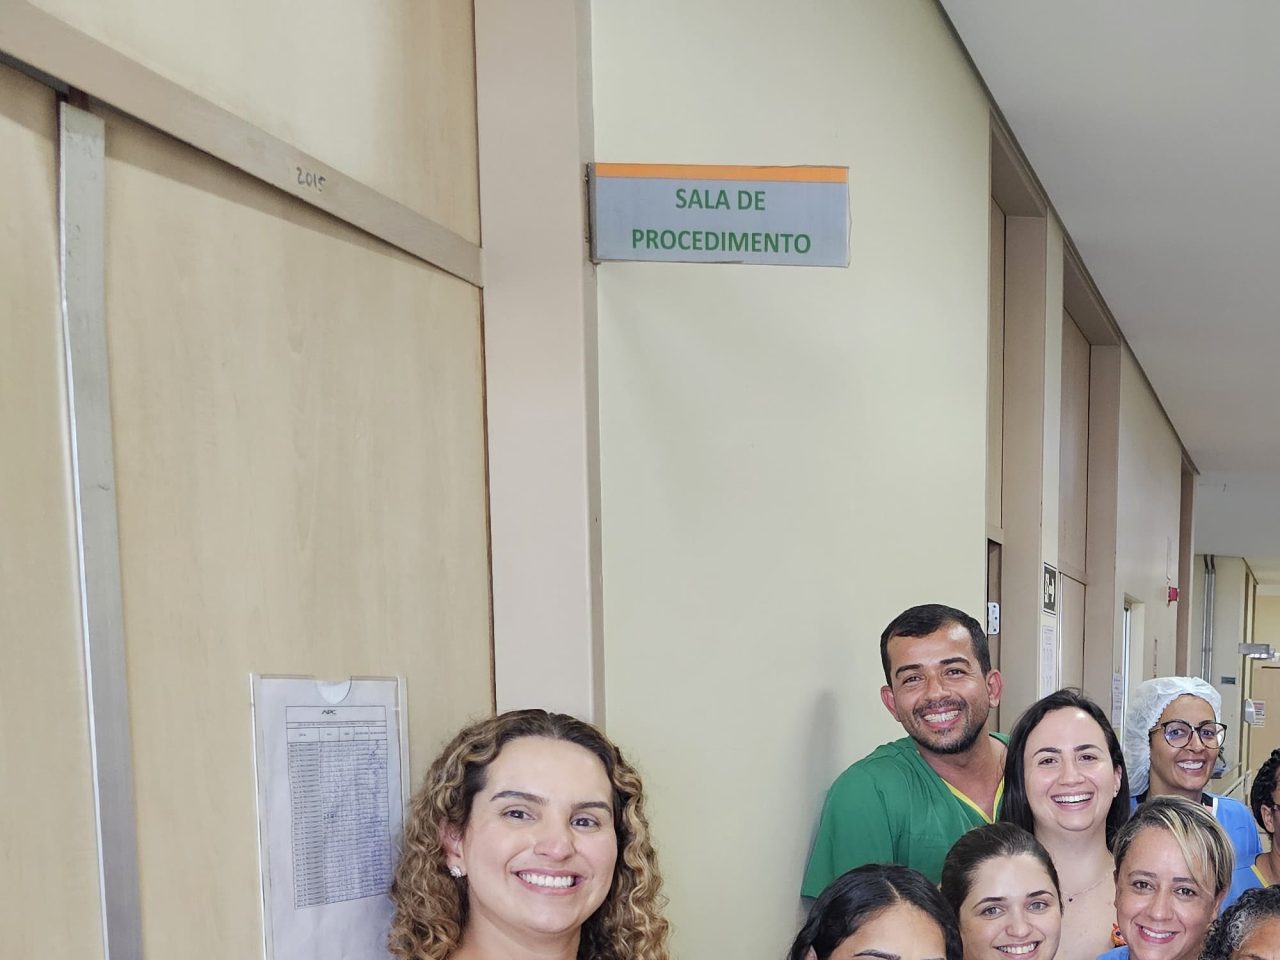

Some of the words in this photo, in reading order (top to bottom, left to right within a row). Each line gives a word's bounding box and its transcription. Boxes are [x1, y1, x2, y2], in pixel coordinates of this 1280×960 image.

[675, 188, 730, 210] SALA
[737, 190, 766, 211] DE
[632, 229, 811, 254] PROCEDIMENTO
